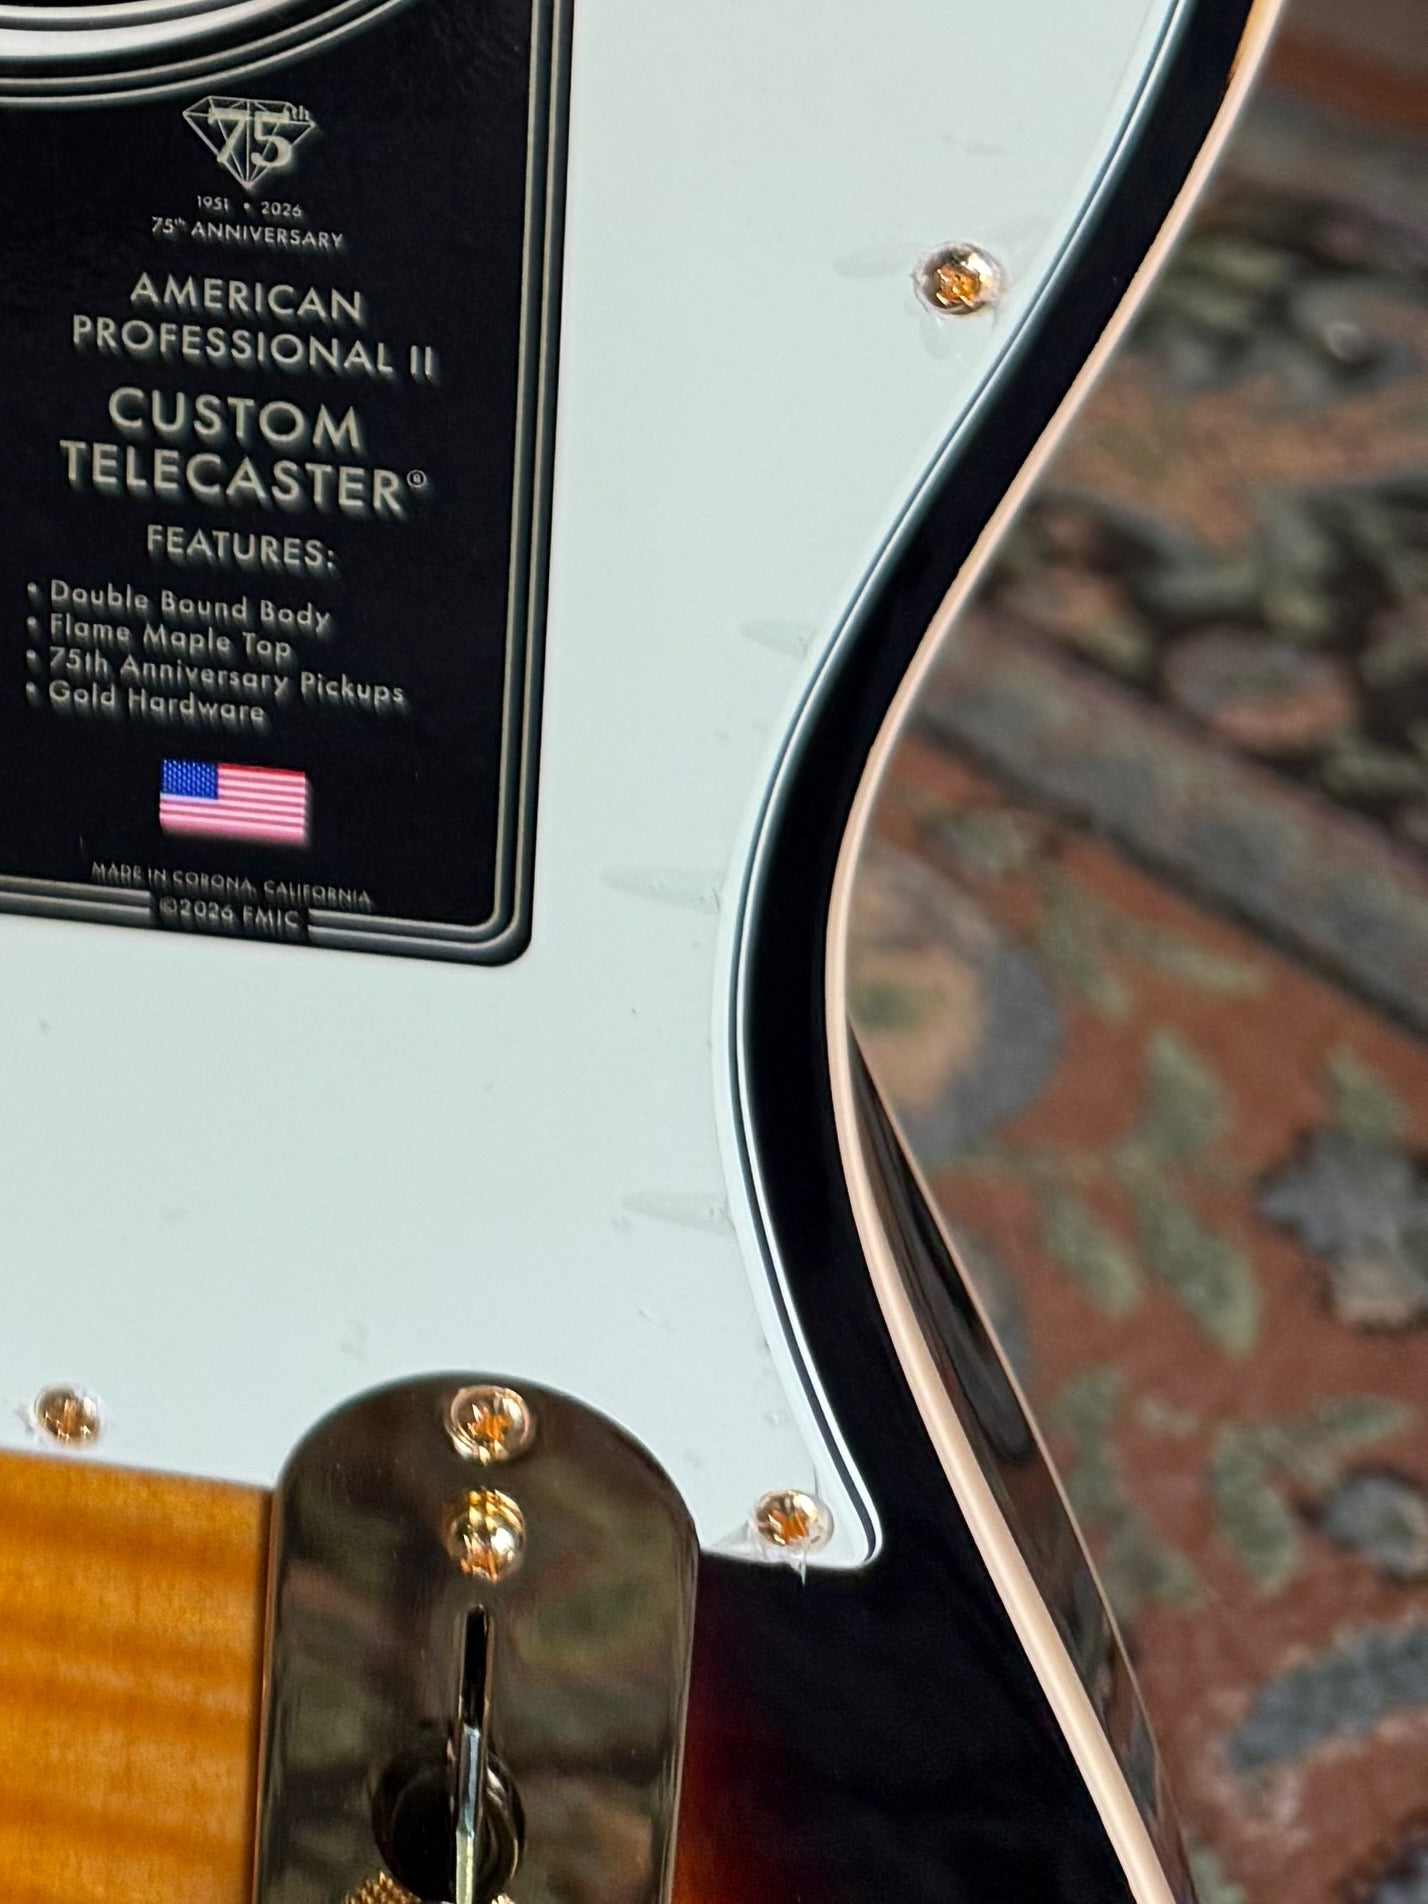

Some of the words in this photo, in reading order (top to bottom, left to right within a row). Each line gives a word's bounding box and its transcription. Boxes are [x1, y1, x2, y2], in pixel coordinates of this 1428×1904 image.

[197, 195, 229, 212] 1951
[261, 200, 302, 219] 2026
[191, 221, 344, 249] ANNIVERSARY
[130, 271, 362, 323] AMERICAN
[72, 314, 393, 375] PROFESSIONAL
[410, 345, 435, 380] II
[108, 386, 361, 450] CUSTOM
[147, 524, 336, 569] FEATURES:
[50, 579, 149, 610] Double
[161, 590, 249, 622] Bound
[260, 600, 331, 632] Body
[50, 613, 131, 641] Flame
[144, 624, 231, 660] Maple
[243, 633, 293, 663] Top
[49, 647, 109, 675] 75th
[120, 653, 288, 698] Anniversary
[301, 671, 405, 706] Pickups
[49, 680, 116, 708] Gold
[128, 687, 266, 723] Hardware
[91, 861, 142, 882] MADE
[148, 867, 166, 885] IN
[173, 869, 257, 894] CORONA,
[263, 880, 372, 906] CALIFORNIA
[243, 905, 301, 929] FMIC
